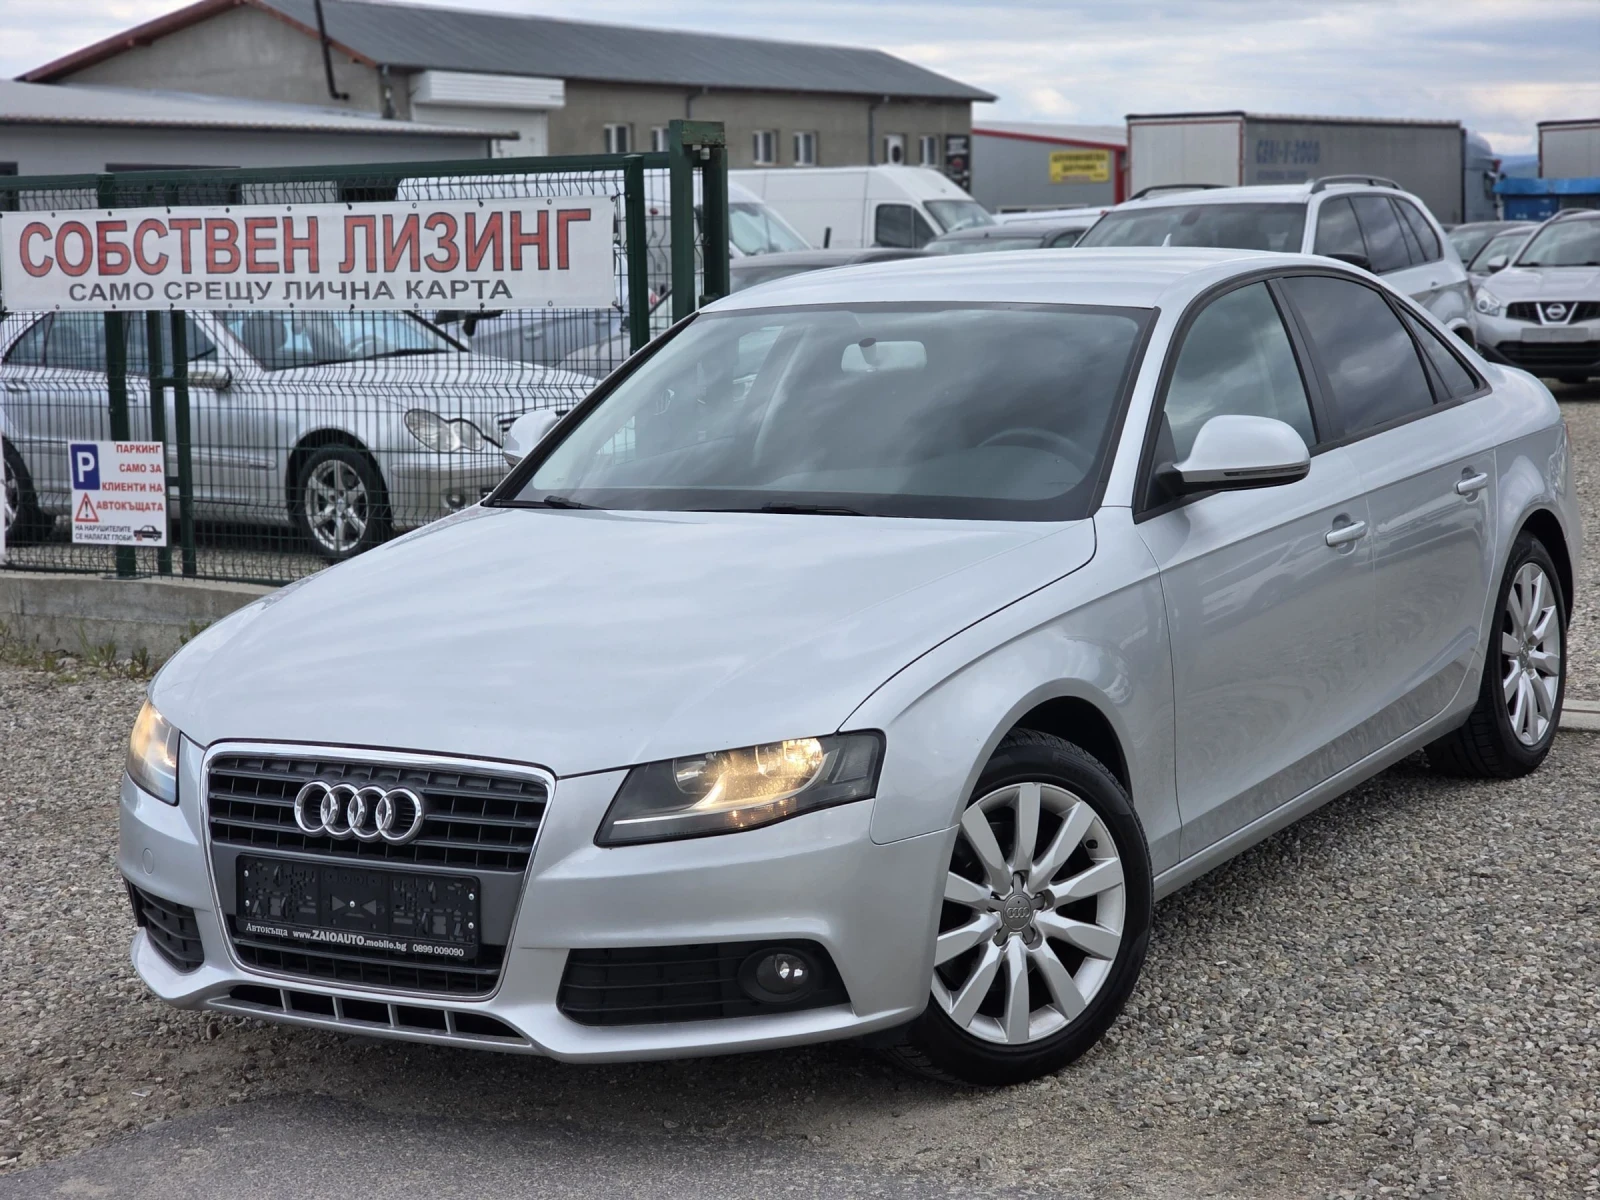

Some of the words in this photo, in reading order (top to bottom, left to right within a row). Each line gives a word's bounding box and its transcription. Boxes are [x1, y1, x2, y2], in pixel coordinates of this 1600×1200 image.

[19, 215, 319, 277] СОБСТВЕН
[338, 208, 592, 275] ЛИЗИНГ
[68, 281, 154, 302] САМО
[163, 280, 272, 302] СРЕЩУ
[281, 280, 392, 301] ЛИЧНА
[405, 279, 513, 300] КАРТА
[116, 444, 160, 453] ПАРКИНГ
[119, 463, 146, 472] САМО
[150, 464, 162, 473] ЗА
[102, 482, 146, 492] КЛИЕНТИ
[149, 483, 162, 492] НА
[96, 501, 164, 512] АВТОКЪЩАТА
[84, 525, 131, 533] НАРУШИТЕЛИТЕ
[84, 533, 110, 541] НАЛАГАТ
[246, 922, 288, 937] Автокъща
[412, 943, 433, 954] 0899
[433, 946, 464, 957] 009090
